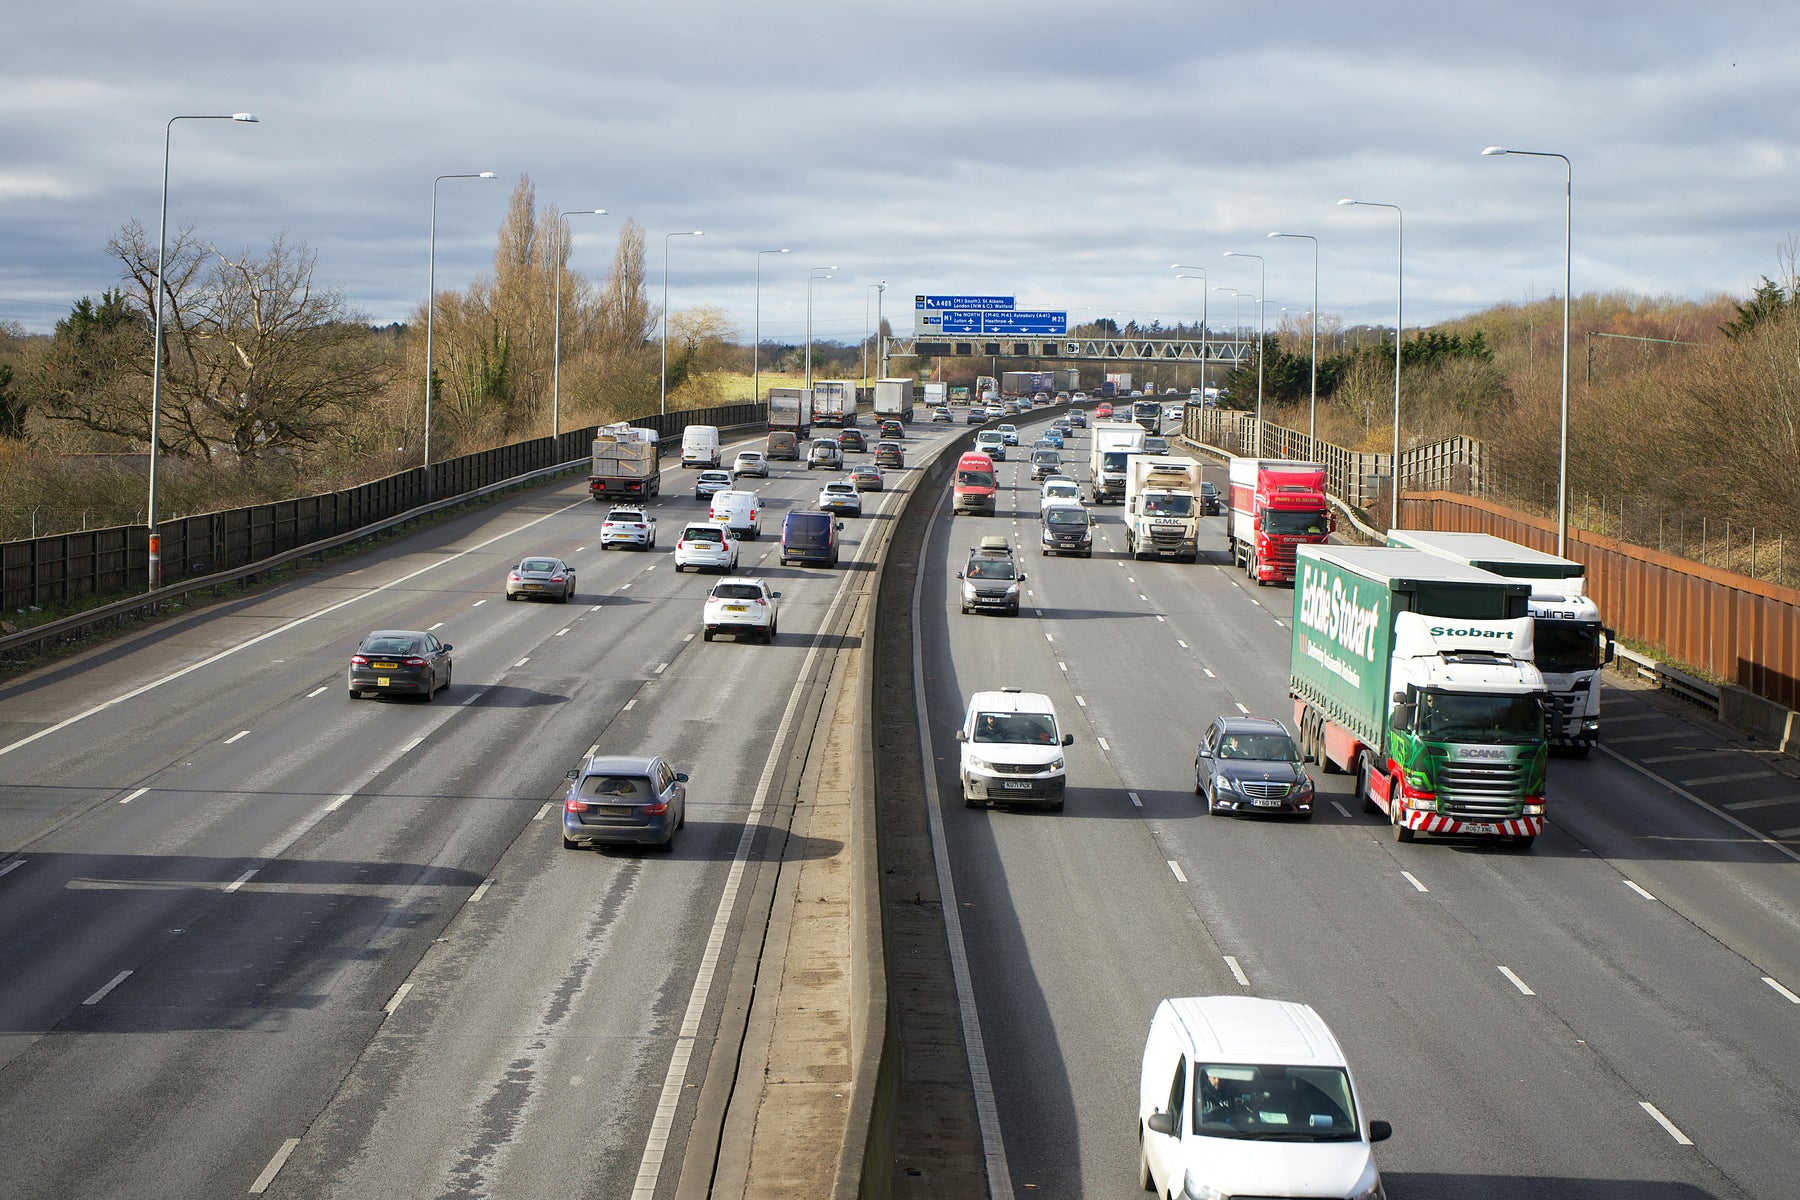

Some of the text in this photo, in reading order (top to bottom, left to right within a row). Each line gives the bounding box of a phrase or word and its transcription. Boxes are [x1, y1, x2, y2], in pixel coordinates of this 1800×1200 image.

[1300, 564, 1379, 662] Eddie Stobart
[1430, 626, 1515, 640] Stobart
[1459, 748, 1507, 759] SCANIA
